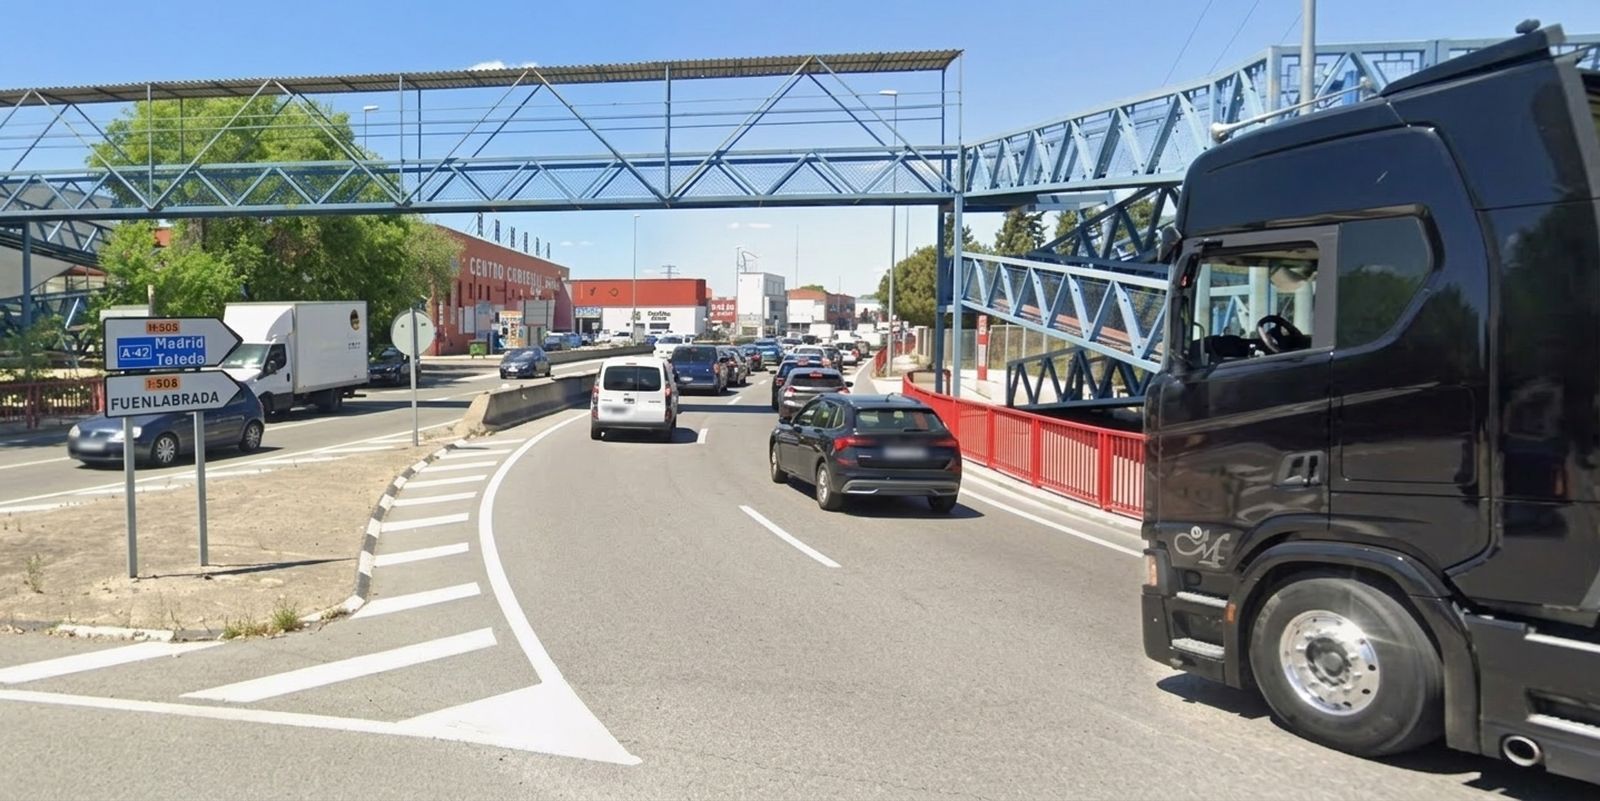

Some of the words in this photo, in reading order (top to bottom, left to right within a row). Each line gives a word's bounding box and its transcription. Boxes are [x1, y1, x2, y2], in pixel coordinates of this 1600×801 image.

[155, 337, 204, 350] Madrid
[121, 348, 149, 358] A-42
[111, 391, 219, 411] FUENLABRADA
